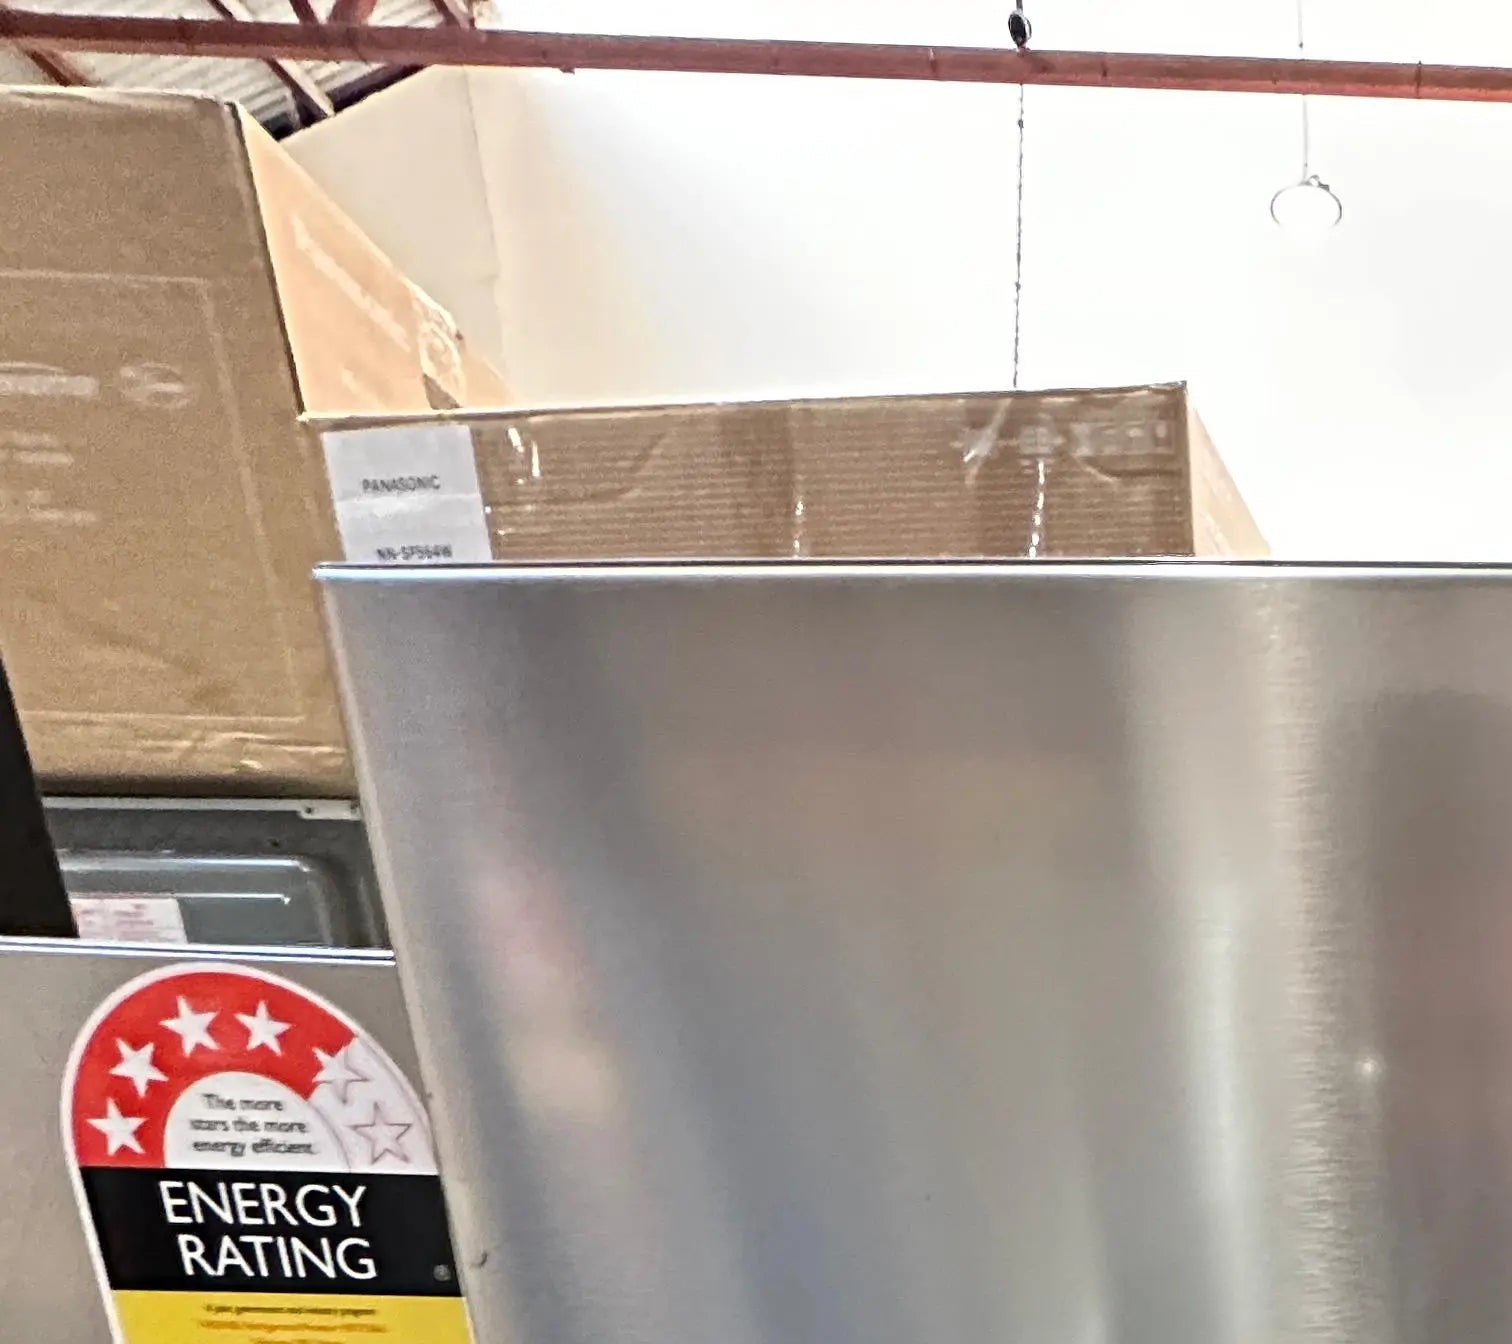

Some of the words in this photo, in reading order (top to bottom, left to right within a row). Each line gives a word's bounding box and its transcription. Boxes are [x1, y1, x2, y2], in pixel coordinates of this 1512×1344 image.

[362, 475, 440, 492] PANASONIC
[159, 1181, 366, 1227] ENERGY
[177, 1234, 377, 1279] RATING
